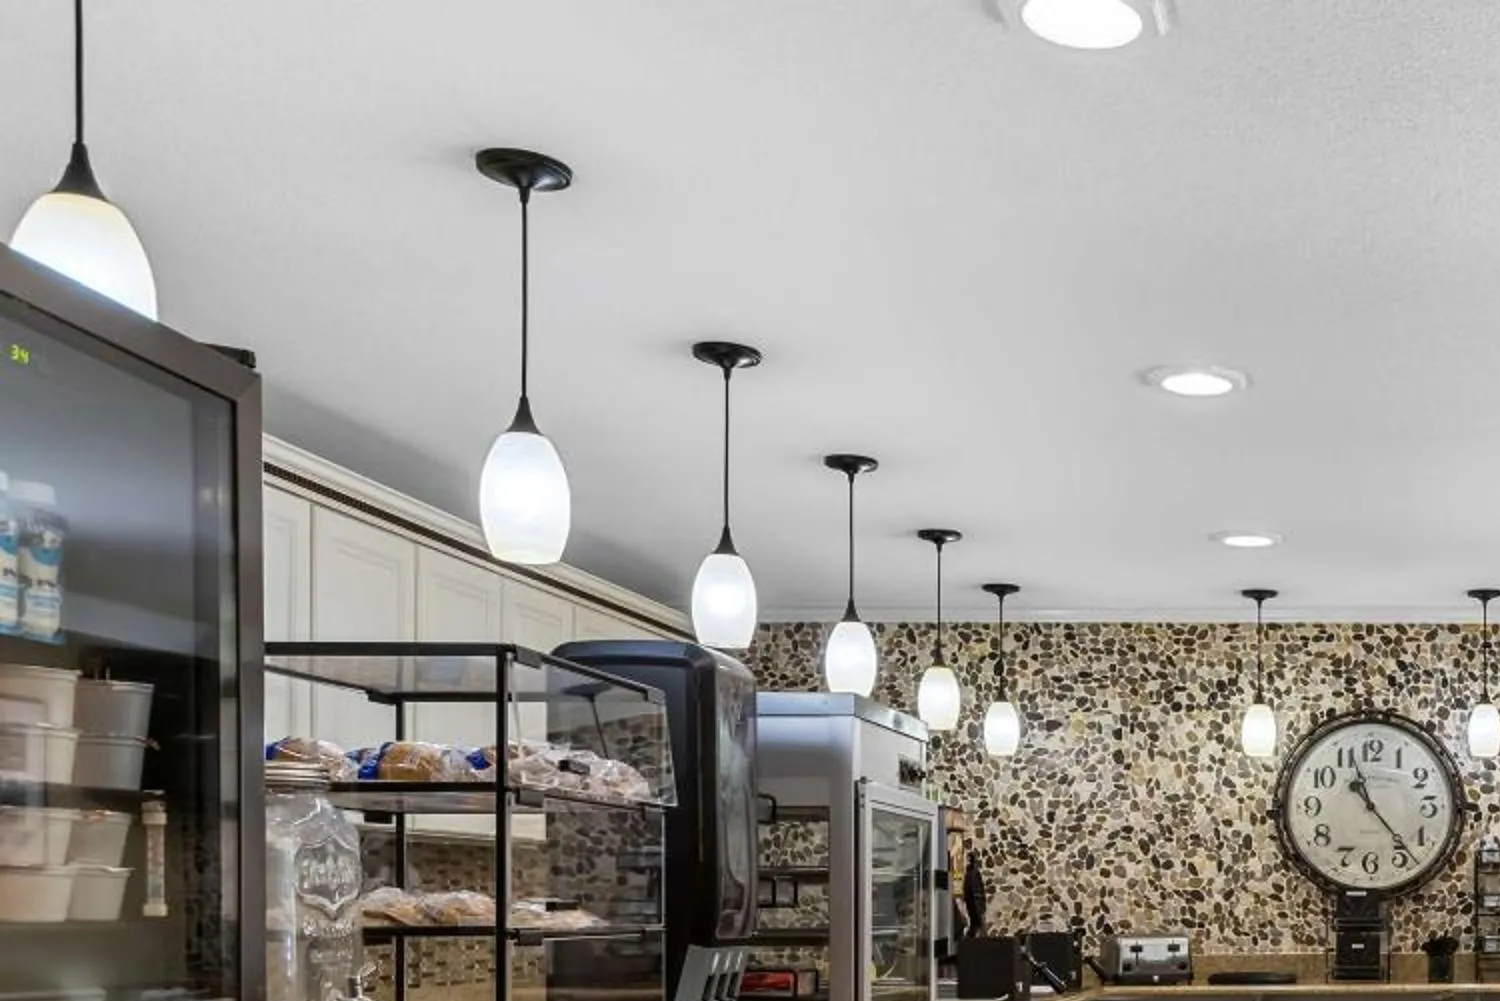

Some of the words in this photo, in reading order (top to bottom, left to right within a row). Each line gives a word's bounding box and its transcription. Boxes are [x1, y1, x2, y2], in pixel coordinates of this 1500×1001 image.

[11, 344, 29, 364] 34
[1337, 747, 1355, 768] 11
[1362, 740, 1384, 762] 12
[1396, 747, 1402, 768] 1
[1313, 766, 1336, 788] 10
[1413, 767, 1428, 788] 2
[1304, 796, 1321, 817] 9
[1420, 795, 1438, 818] 3
[1314, 824, 1331, 846] 8
[1336, 846, 1355, 867] 7
[1362, 852, 1379, 874] 6
[1392, 845, 1408, 868] 5
